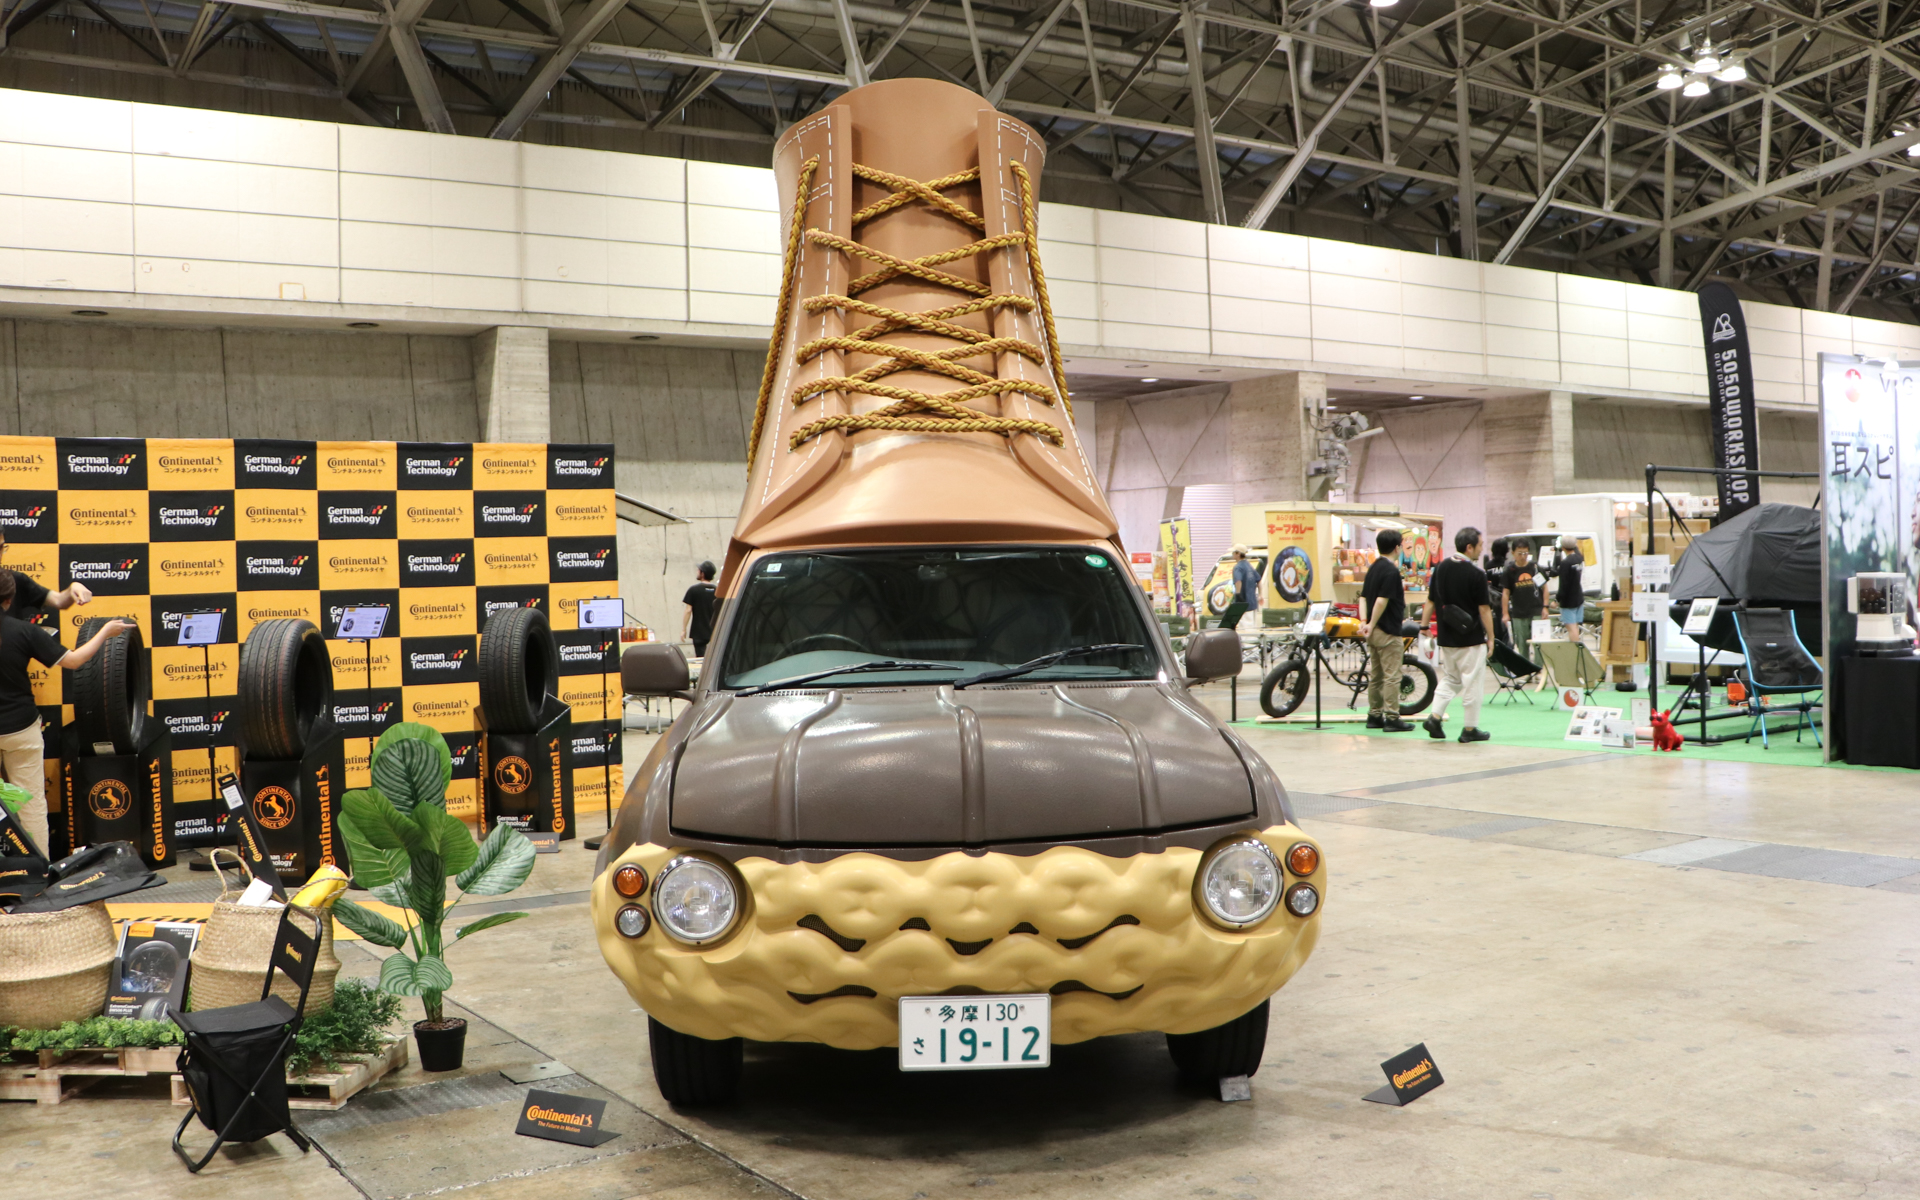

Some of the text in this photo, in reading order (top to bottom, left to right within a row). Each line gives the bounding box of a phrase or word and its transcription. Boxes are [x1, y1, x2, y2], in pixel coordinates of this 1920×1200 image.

[1714, 353, 1725, 402] OUTDOOR
[0, 455, 34, 464] nental
[68, 454, 109, 464] German
[159, 456, 214, 468] Continental
[245, 455, 281, 464] German
[327, 457, 378, 468] Continental
[406, 458, 440, 466] German
[482, 459, 529, 469] Continental
[1832, 442, 1894, 482] 耳スピ
[68, 464, 129, 474] Technology
[245, 464, 300, 474] Technology
[406, 466, 457, 476] Technology
[555, 466, 602, 476] Technology
[70, 508, 128, 520] Continental
[159, 508, 198, 516] German
[246, 506, 298, 518] Continental
[328, 506, 363, 515] German
[407, 507, 456, 517] Continental
[556, 506, 600, 515] Continental
[0, 518, 38, 527] nology
[160, 516, 217, 526] Technology
[328, 515, 380, 524] Technology
[483, 514, 531, 522] Technology
[1268, 524, 1314, 534] キーマカレー
[246, 557, 283, 566] German
[329, 556, 380, 568] Continental
[485, 553, 531, 564] Continental
[558, 559, 604, 568] Technology
[70, 561, 111, 570] German
[161, 560, 216, 571] Continental
[247, 566, 302, 575] Technology
[408, 563, 459, 573] Technology
[70, 570, 130, 580] Technology
[248, 608, 301, 620] Continental
[410, 604, 458, 615] Continental
[162, 612, 182, 621] Ger
[164, 662, 218, 676] Continenal
[411, 660, 462, 669] Technology
[333, 706, 369, 714] German
[413, 700, 462, 713] Continental
[165, 716, 203, 724] German
[498, 757, 528, 770] CONTINENTAL
[92, 780, 128, 795] CONTINENTAL
[550, 751, 565, 833] Continental
[257, 788, 292, 802] CONTINENTAL
[96, 809, 112, 819] SINCE
[150, 773, 166, 861] Continental
[175, 818, 206, 827] erman
[260, 817, 276, 827] SINCE
[8, 832, 30, 855] nental
[240, 823, 262, 862] Continental
[938, 1003, 1018, 1022] 多摩 130
[913, 1026, 1040, 1063] さ 19-12
[1393, 1060, 1428, 1089] Continental
[527, 1105, 585, 1125] Continental
